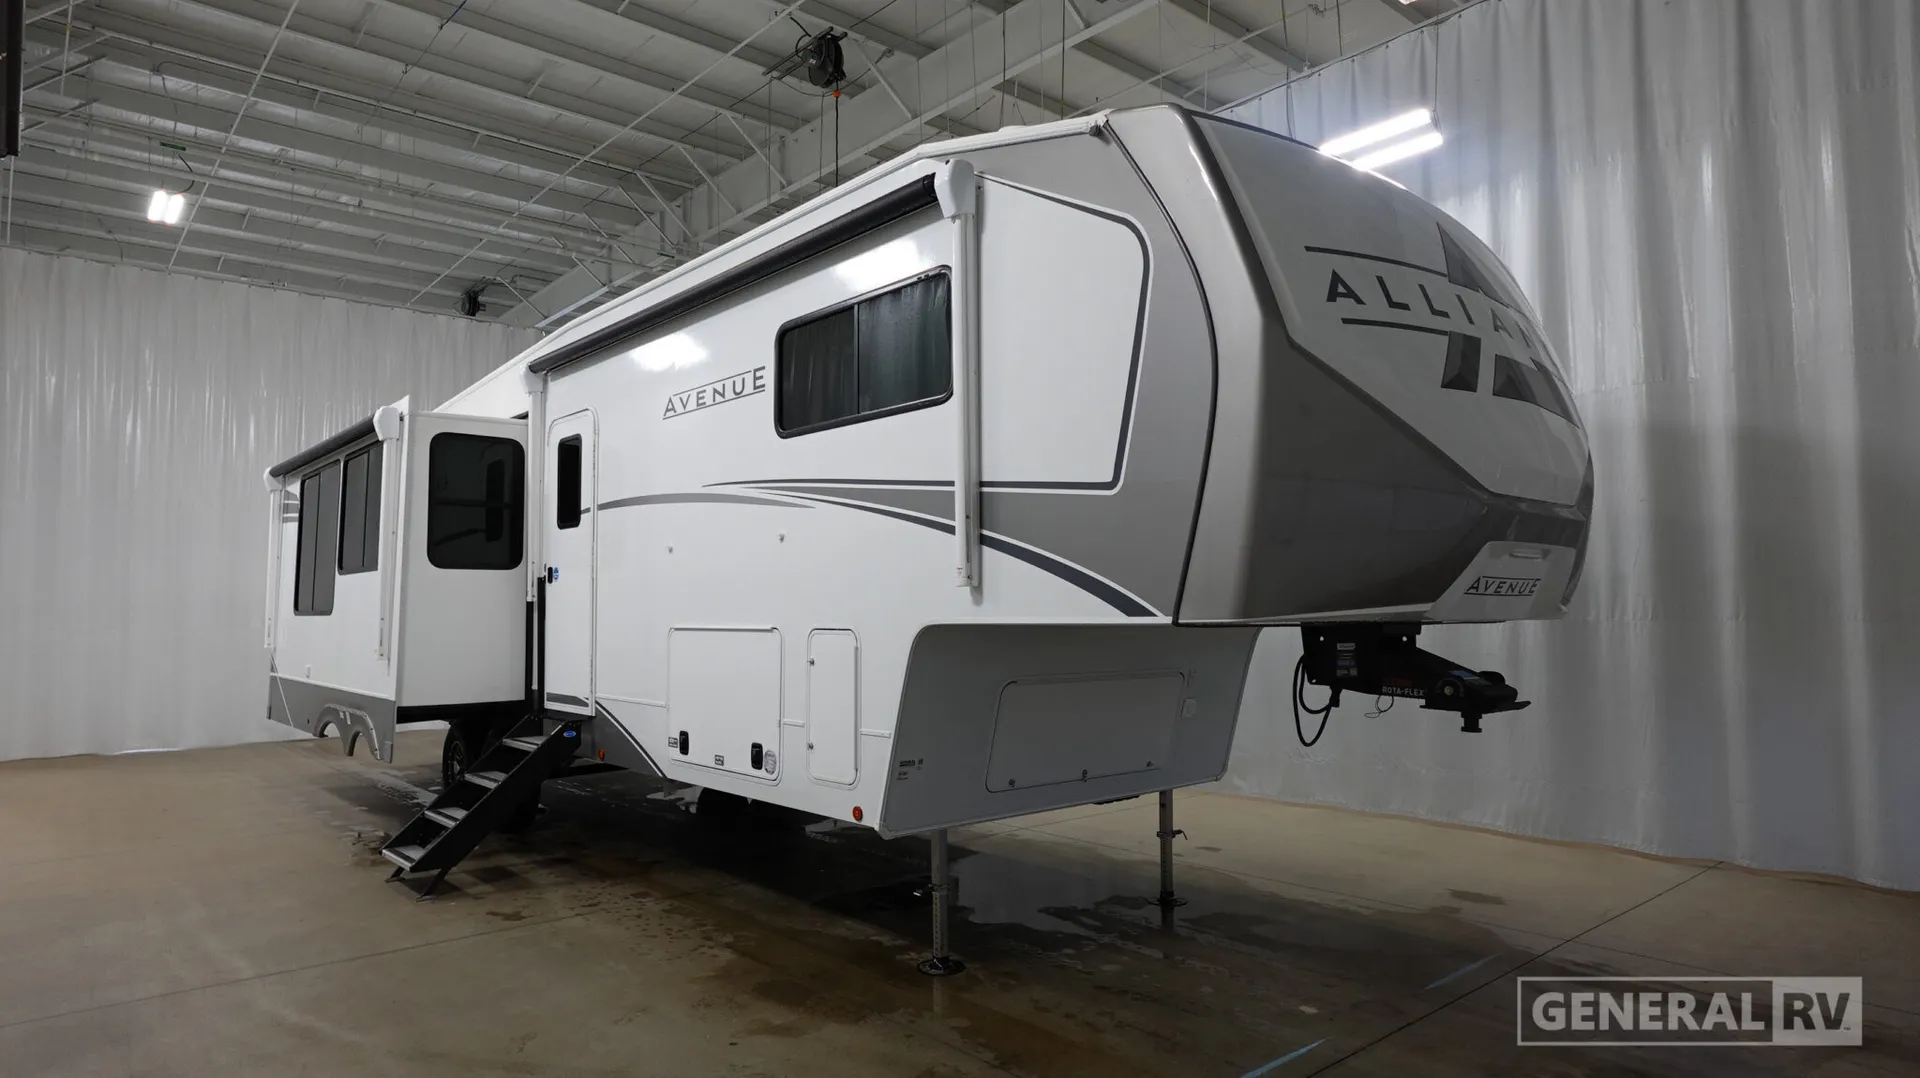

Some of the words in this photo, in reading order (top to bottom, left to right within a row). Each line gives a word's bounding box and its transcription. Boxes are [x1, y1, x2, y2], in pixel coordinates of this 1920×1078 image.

[662, 365, 766, 418] AVENUE
[1465, 576, 1541, 595] AVENUE
[1381, 686, 1425, 697] ROTA-FLEX
